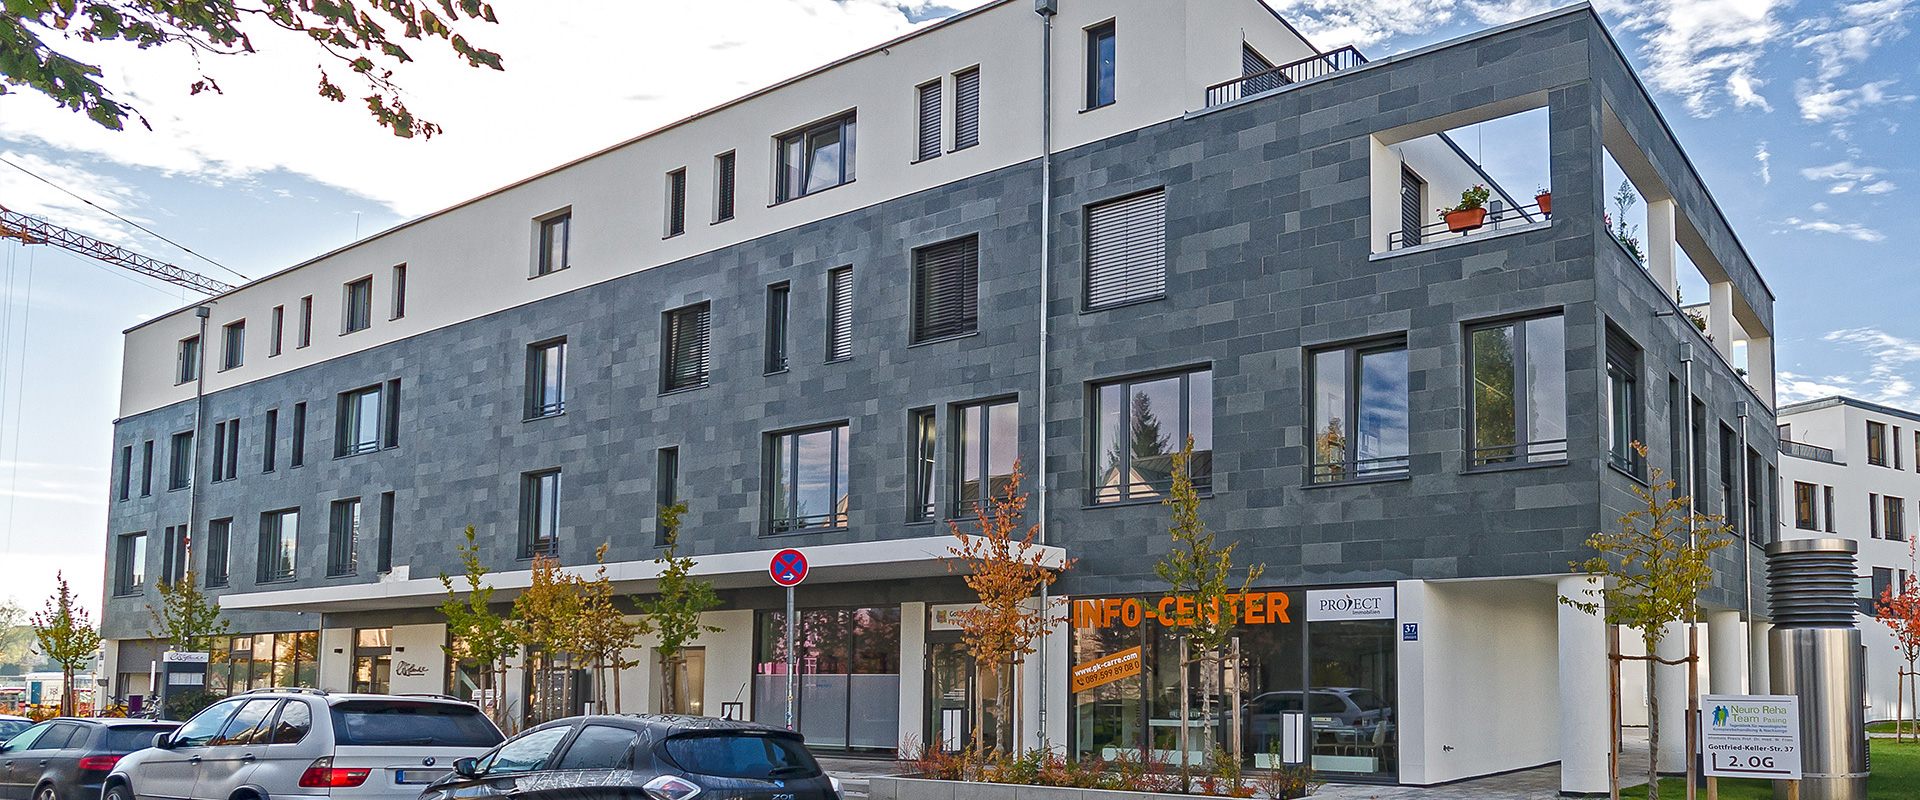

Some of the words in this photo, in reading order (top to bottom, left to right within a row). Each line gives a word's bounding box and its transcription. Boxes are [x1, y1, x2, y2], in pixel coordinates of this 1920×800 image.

[1320, 594, 1381, 611] PROJECT
[1073, 592, 1291, 629] INFO-CENTER
[1404, 625, 1416, 633] 37
[1074, 652, 1138, 677] www.gk-carre.com
[1085, 669, 1113, 684] 089.599
[1114, 665, 1123, 675] 89
[1124, 663, 1133, 672] 08
[1134, 661, 1140, 669] 0
[1731, 705, 1760, 714] Neuro
[1762, 705, 1787, 714] Reha
[1732, 714, 1759, 723] Team
[1708, 744, 1783, 752] Gottfried-Keller-Str.
[1729, 756, 1744, 767] 2.
[1748, 756, 1774, 768] OG
